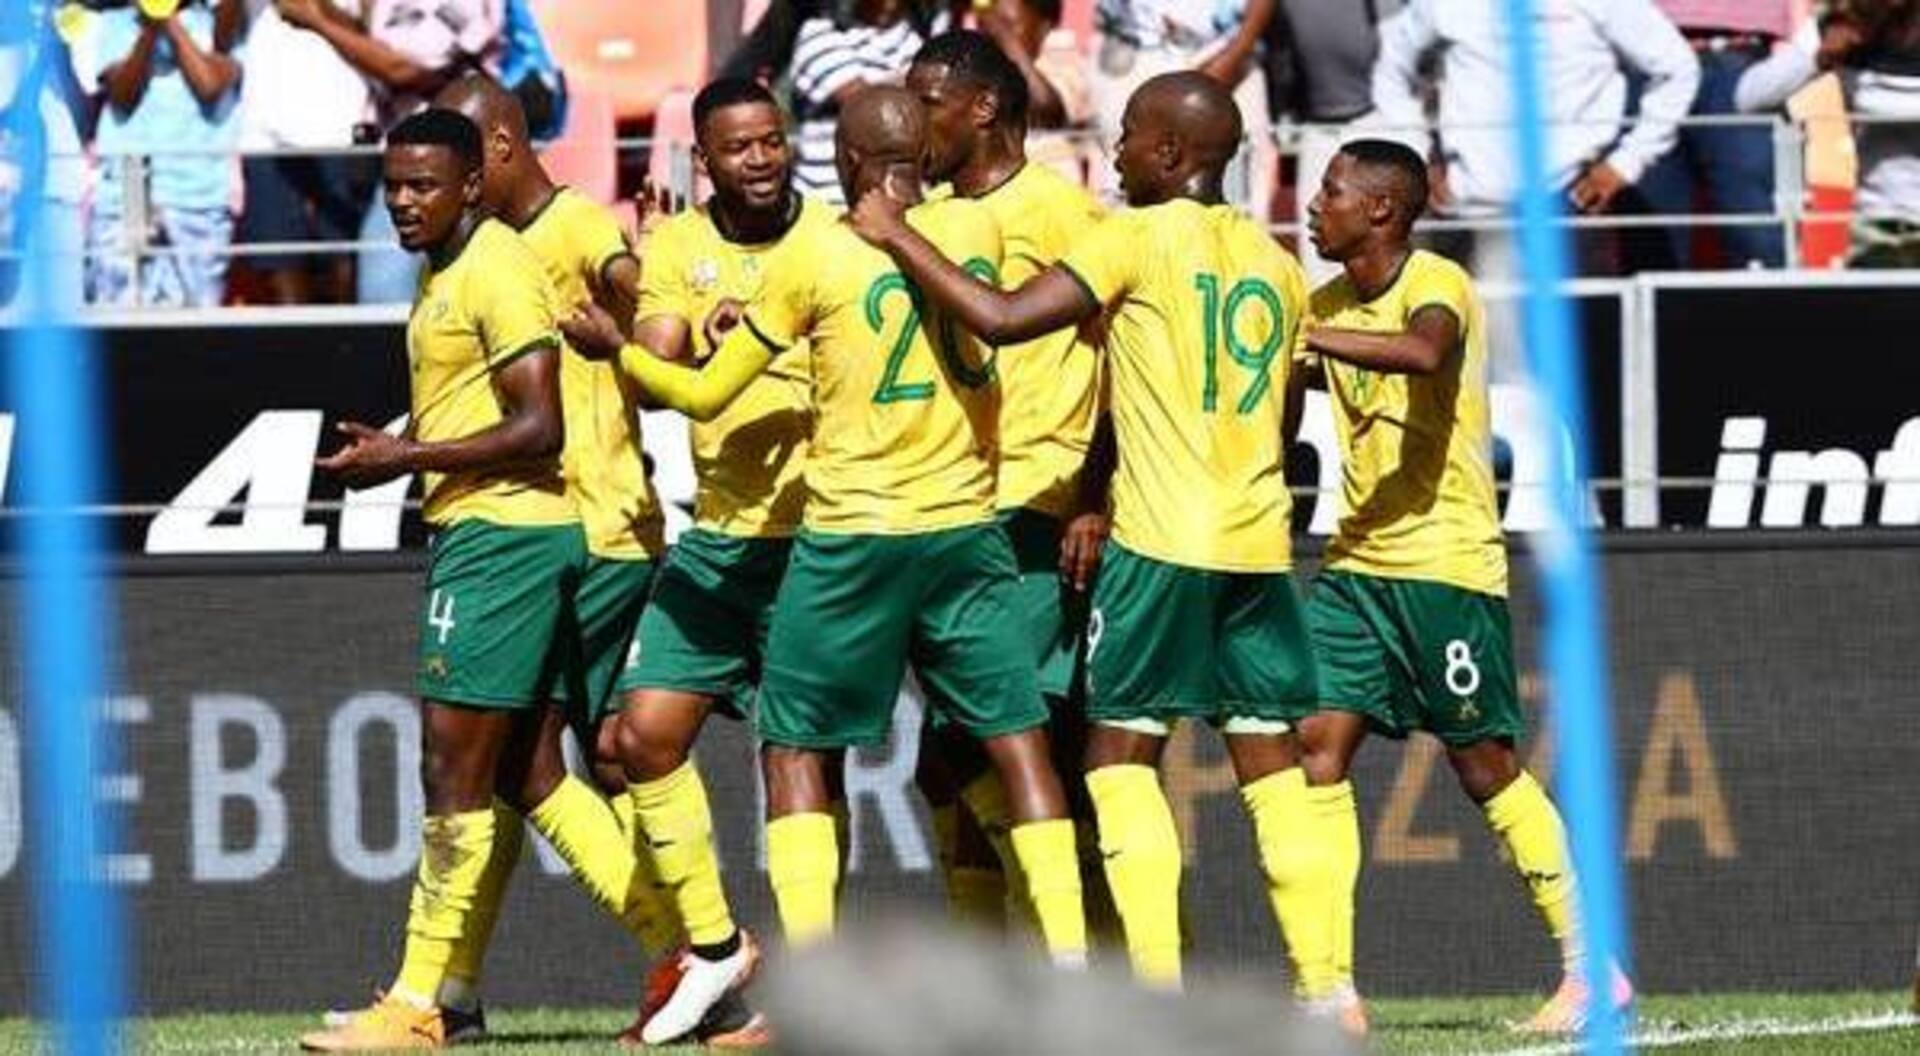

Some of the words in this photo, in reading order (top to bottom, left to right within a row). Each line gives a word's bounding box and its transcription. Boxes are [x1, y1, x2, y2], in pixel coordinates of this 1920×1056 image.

[866, 256, 1000, 404] 20
[1195, 272, 1284, 415] 19
[429, 588, 456, 645] 4
[1445, 639, 1480, 697] 8
